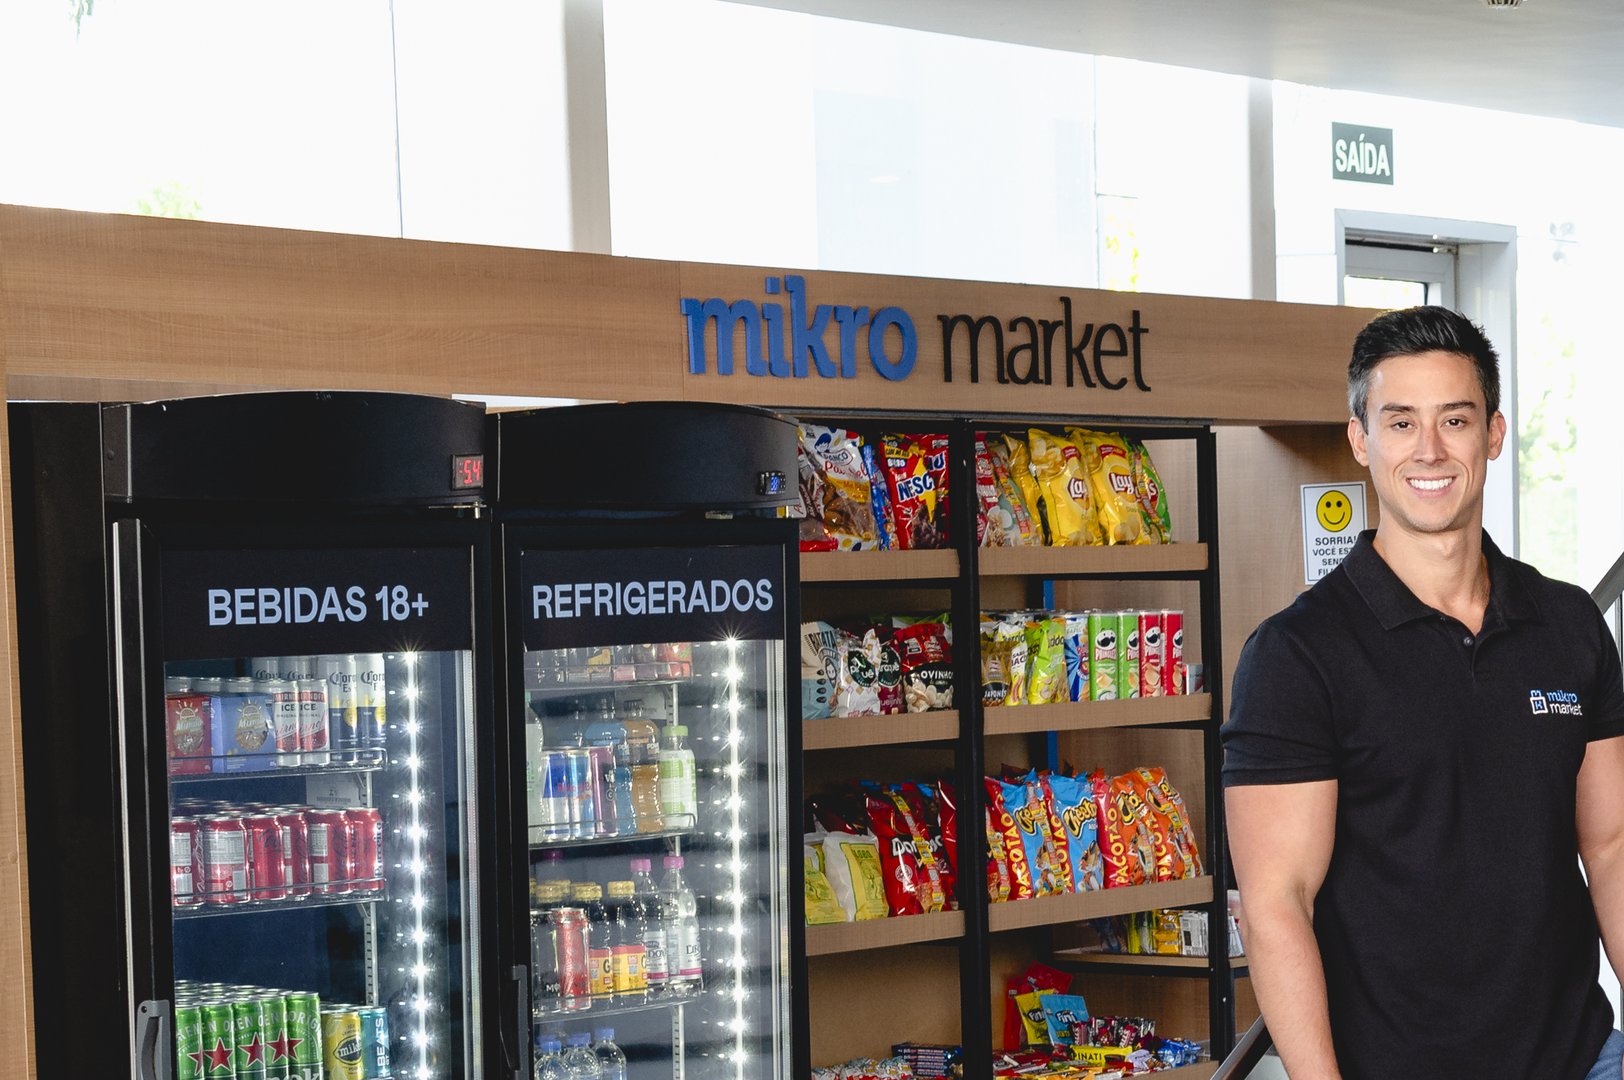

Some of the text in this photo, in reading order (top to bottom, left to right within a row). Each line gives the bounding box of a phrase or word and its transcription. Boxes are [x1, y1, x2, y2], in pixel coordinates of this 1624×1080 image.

[1335, 133, 1391, 177] SAÍDA
[681, 274, 1152, 392] mikro market
[896, 471, 936, 503] NESC
[1110, 473, 1134, 494] Lay
[1312, 545, 1337, 556] VOCÊ
[208, 585, 429, 625] BEBIDAS 18+
[532, 578, 774, 619] REFRIGERADOS
[281, 703, 295, 712] ICE
[1546, 690, 1578, 703] mikro
[1549, 702, 1583, 716] market
[1063, 799, 1098, 837] Cheeto
[1057, 1011, 1076, 1025] Fini
